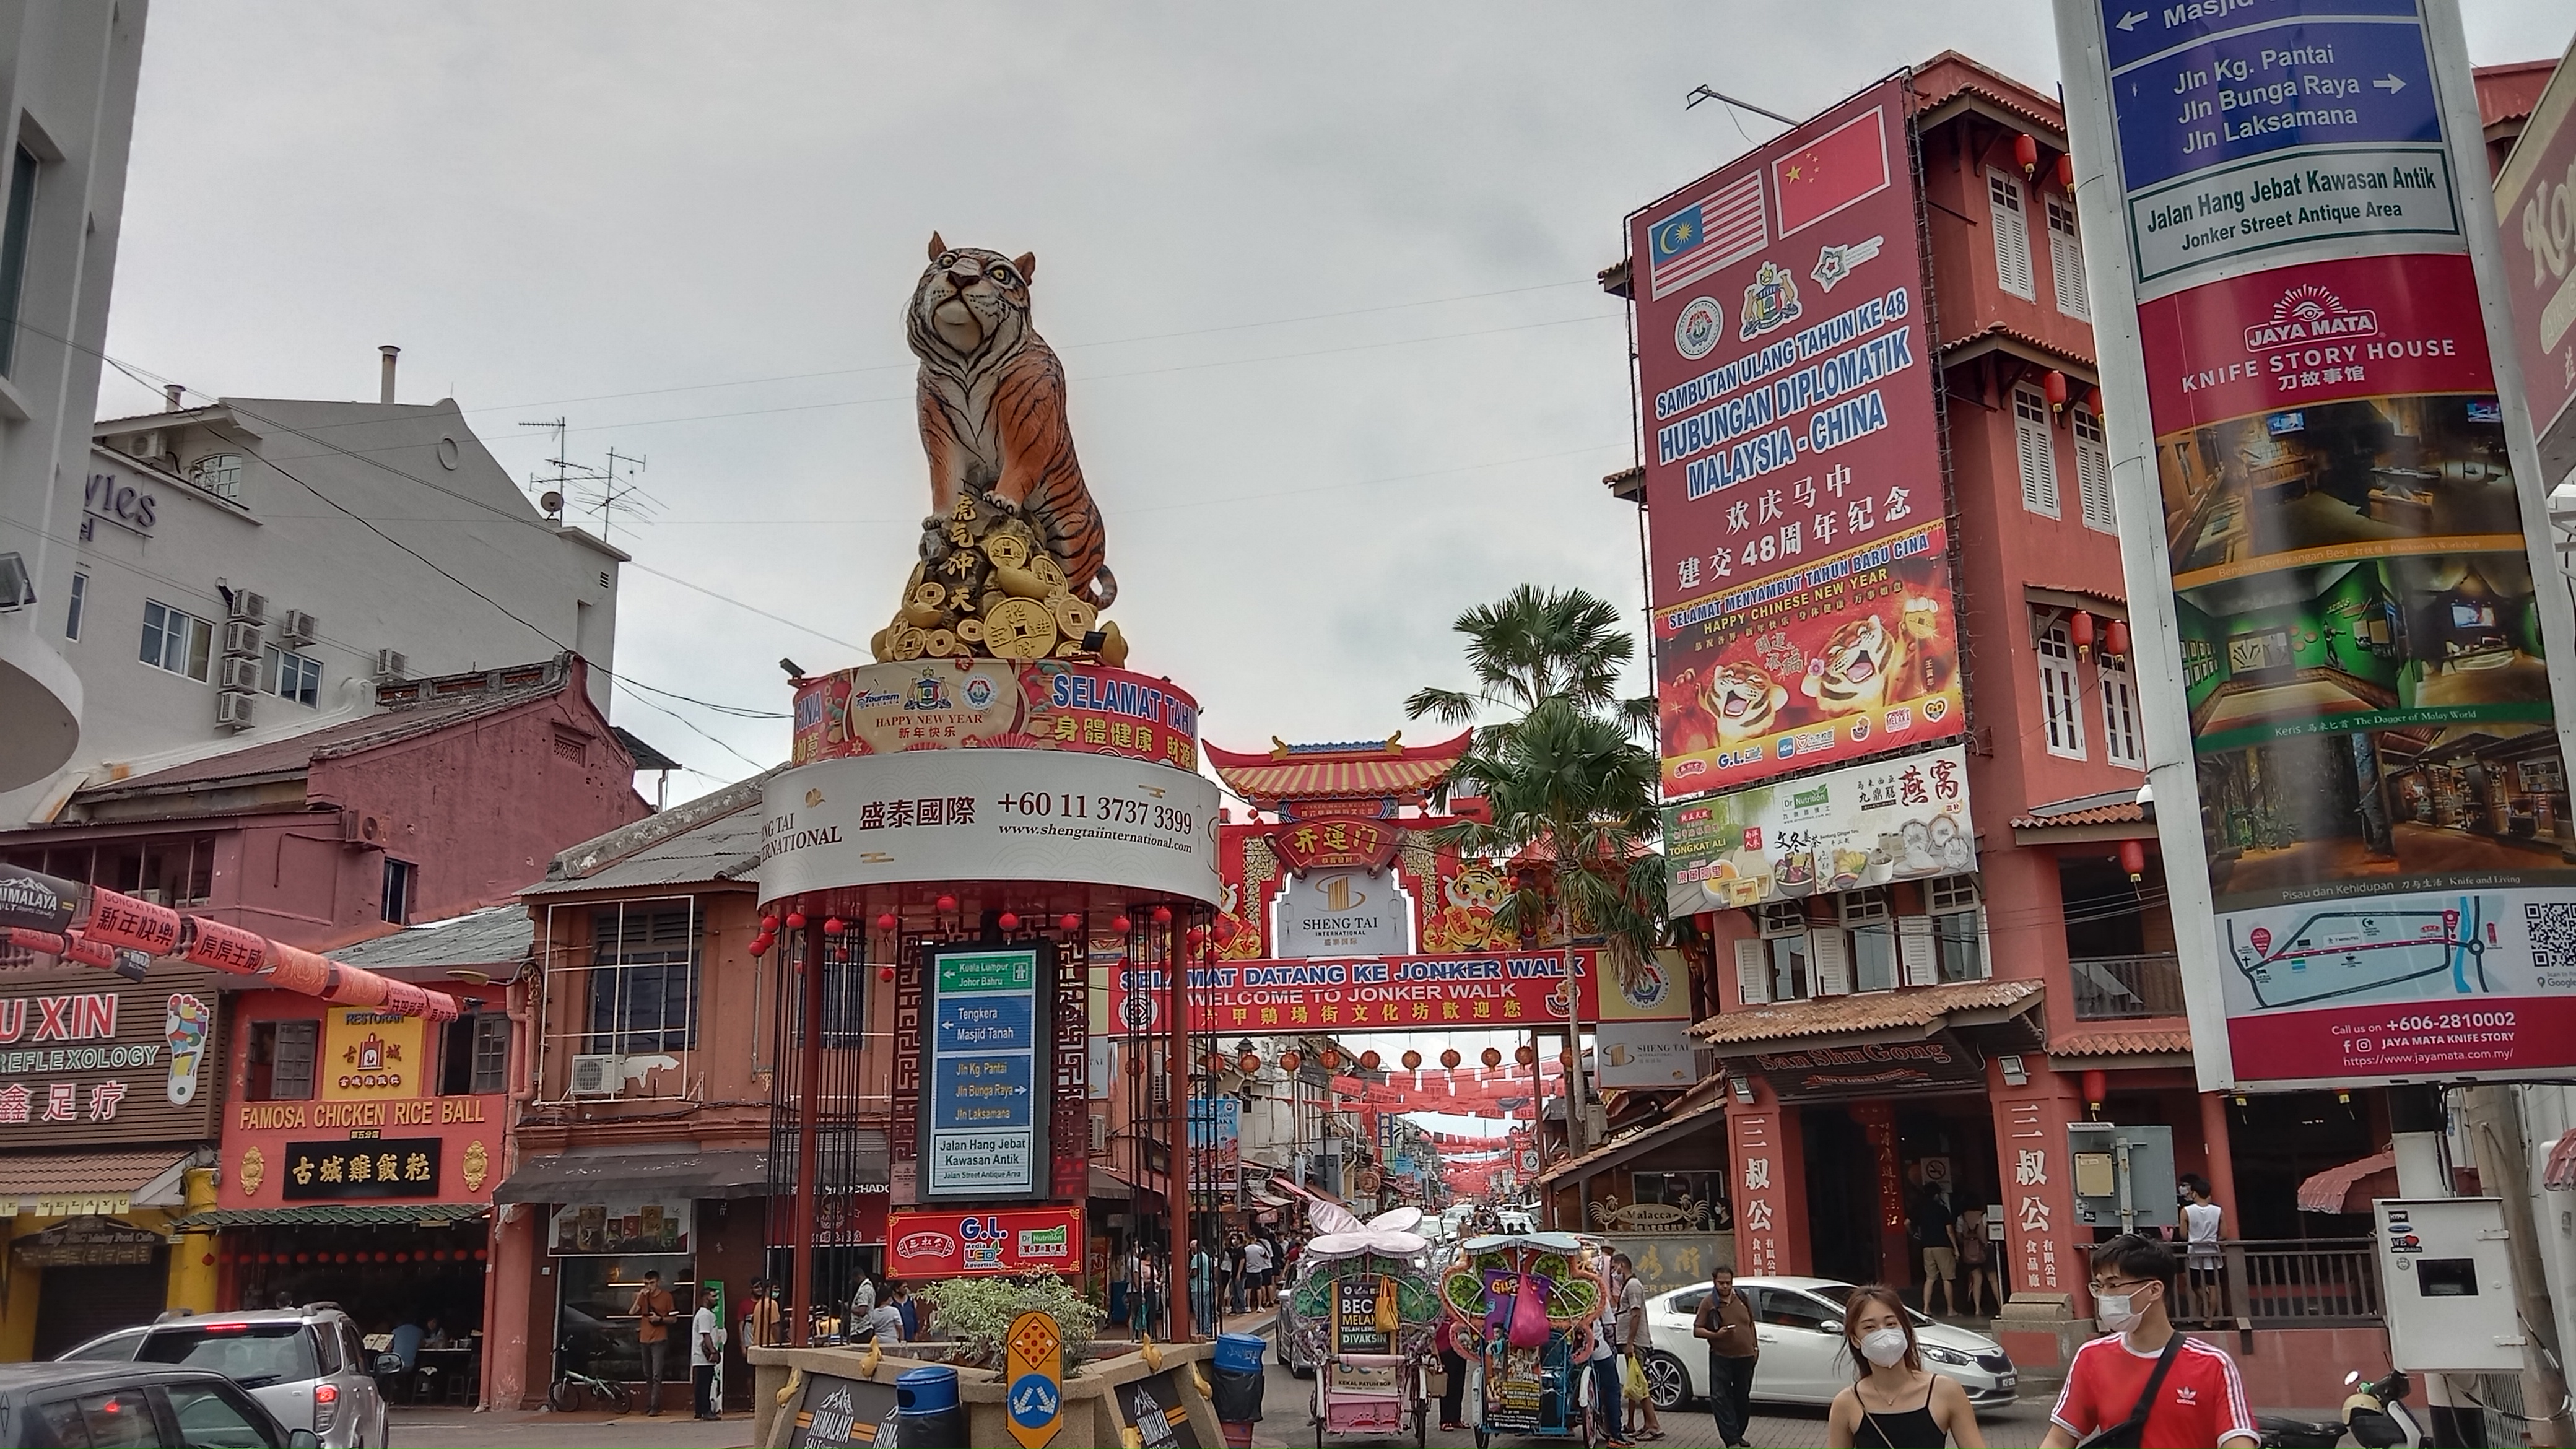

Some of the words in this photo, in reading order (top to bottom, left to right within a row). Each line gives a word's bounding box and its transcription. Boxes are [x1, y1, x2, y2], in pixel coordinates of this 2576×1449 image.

[2174, 70, 2208, 95] Jln
[2213, 58, 2255, 82] Kg.
[2261, 43, 2334, 71] Pantai
[2178, 98, 2213, 124] Jln
[2221, 78, 2299, 112] Bunga
[2304, 74, 2361, 102] Raya
[2182, 128, 2217, 155] Jln
[2224, 107, 2358, 142] Laksamana
[2147, 204, 2193, 233] Jalan
[2197, 187, 2244, 217] Hang
[2250, 172, 2301, 204] Jebat
[2306, 167, 2388, 193] Kawasan
[2393, 165, 2437, 191] Antik
[2181, 224, 2236, 251] Jonker
[2240, 212, 2294, 236] Street
[2298, 204, 2363, 225] Antique
[2366, 203, 2403, 219] Area
[2248, 324, 2305, 347] JAYA
[2311, 314, 2374, 336] MATA
[1657, 367, 1738, 419] SAMBUTAN
[1740, 342, 1794, 381] ULANG
[1797, 313, 1854, 358] TAHUN
[1858, 300, 1882, 331] KE
[1884, 290, 1907, 318] 48
[2182, 360, 2259, 394] KNIFE
[2270, 345, 2357, 373] STORY
[2369, 339, 2456, 361] HOUSE
[2278, 365, 2365, 392] 刀故事馆
[1659, 389, 1772, 463] HUBUNGAN
[1777, 329, 1910, 417] DIPLOMATIK
[1687, 429, 1794, 498] MALAYSIA
[1811, 392, 1886, 451] CHINA
[1725, 464, 1852, 536] 欢庆马中
[1677, 486, 1912, 592] 建交48周年纪念
[1669, 598, 1723, 629] SELAMAT
[1725, 575, 1803, 614] MENYAMBUT
[1805, 562, 1850, 588] TAHUN
[1853, 550, 1890, 573] BARU
[1894, 534, 1929, 559] CINA
[1703, 613, 1746, 635] HAPPY
[1750, 595, 1810, 622] CHINESE
[1814, 581, 1845, 605] NEW
[1849, 568, 1888, 591] YEAR
[865, 692, 900, 704] Tourism
[1053, 674, 1162, 723] SELAMAT
[876, 716, 912, 728] HAPPY
[917, 716, 945, 725] NEW
[949, 714, 983, 724] YEAR
[899, 726, 957, 739] 新年快乐
[1055, 716, 1153, 752] 身體健康
[2274, 724, 2302, 737] Keris
[2353, 717, 2372, 726] The
[2374, 715, 2407, 724] Dagger
[2408, 713, 2419, 721] of
[2421, 711, 2448, 722] Malay
[2450, 710, 2477, 719] World
[859, 796, 976, 830] 盛泰國際
[998, 791, 1052, 816] +60
[1061, 794, 1087, 818] 11
[1096, 797, 1149, 825] 3737
[1154, 806, 1192, 835] 3399
[1784, 799, 1793, 807] Dr
[1795, 793, 1825, 804] Nutrition
[775, 812, 794, 834] TAI
[999, 824, 1193, 853] www.shengtaiinternational.com
[1668, 841, 1710, 856] TONGKAT
[1712, 838, 1727, 848] ALI
[2282, 889, 2311, 900] Pisau
[2313, 887, 2334, 898] dan
[2336, 881, 2395, 895] Kehidupan
[2448, 876, 2474, 886] Knife
[2475, 875, 2493, 885] and
[2494, 874, 2521, 885] Living
[104, 893, 133, 908] GONG
[134, 901, 144, 912] XI
[96, 905, 175, 947] 新年快樂
[1303, 918, 1351, 930] SHENG
[1354, 917, 1378, 928] TAI
[959, 963, 980, 972] Kuala
[981, 962, 1009, 972] Lumpur
[1245, 965, 1345, 987] DATANG
[1354, 963, 1388, 983] KE
[1396, 960, 1503, 980] JONKER
[1508, 957, 1586, 980] WALK
[959, 978, 980, 986] Johor
[981, 977, 1003, 986] Bahru
[1188, 991, 1304, 1007] WELCOME
[1310, 989, 1342, 1003] TO
[1347, 985, 1443, 1003] JONKER
[1448, 982, 1516, 999] WALK
[32, 993, 119, 1042] XIN
[958, 1007, 998, 1022] Tengkera
[2331, 1025, 2351, 1035] Call
[2368, 1025, 2382, 1033] on
[2387, 1012, 2516, 1032] +606-2810002
[957, 1028, 986, 1043] Masjid
[987, 1027, 1014, 1039] Tanah
[1637, 1044, 1671, 1053] SHENG
[1673, 1043, 1690, 1051] TAI
[2380, 1035, 2410, 1050] JAYA
[2412, 1035, 2445, 1046] MATA
[2447, 1033, 2479, 1045] KNIFE
[2480, 1032, 2515, 1043] STORY
[955, 1064, 968, 1076] Jln
[969, 1063, 982, 1077] Kg.
[983, 1061, 1007, 1074] Pantai
[2343, 1048, 2514, 1068] https://www.jayamata.com.my/
[0, 1079, 129, 1124] 鑫足疗
[955, 1086, 967, 1097] Jln
[968, 1084, 993, 1099] Bunga
[994, 1084, 1013, 1099] Raya
[240, 1105, 307, 1129] FAMOSA
[313, 1102, 386, 1128] CHICKEN
[394, 1101, 433, 1126] RICE
[441, 1100, 485, 1123] BALL
[955, 1109, 967, 1121] Jln
[968, 1108, 1011, 1120] Laksamana
[940, 1139, 967, 1151] Jalan
[969, 1139, 996, 1152] Hang
[998, 1138, 1025, 1149] Jebat
[292, 1152, 431, 1185] 古城雞飯粒
[945, 1155, 991, 1166] Kawasan
[992, 1154, 1019, 1165] Antik
[2011, 1104, 2050, 1233] 三叔公
[981, 1170, 1006, 1179] Antique
[1743, 1118, 1773, 1232] 三叔公
[39, 1199, 128, 1209] MELAYU
[1627, 1209, 1672, 1219] Malacca
[960, 1217, 1009, 1240] G.L.
[1033, 1232, 1063, 1242] Nutrition
[965, 1250, 996, 1261] LED
[965, 1261, 1003, 1269] Advertising
[1342, 1334, 1387, 1344] DIVAKSIN
[809, 1409, 855, 1443] HIMALAYA
